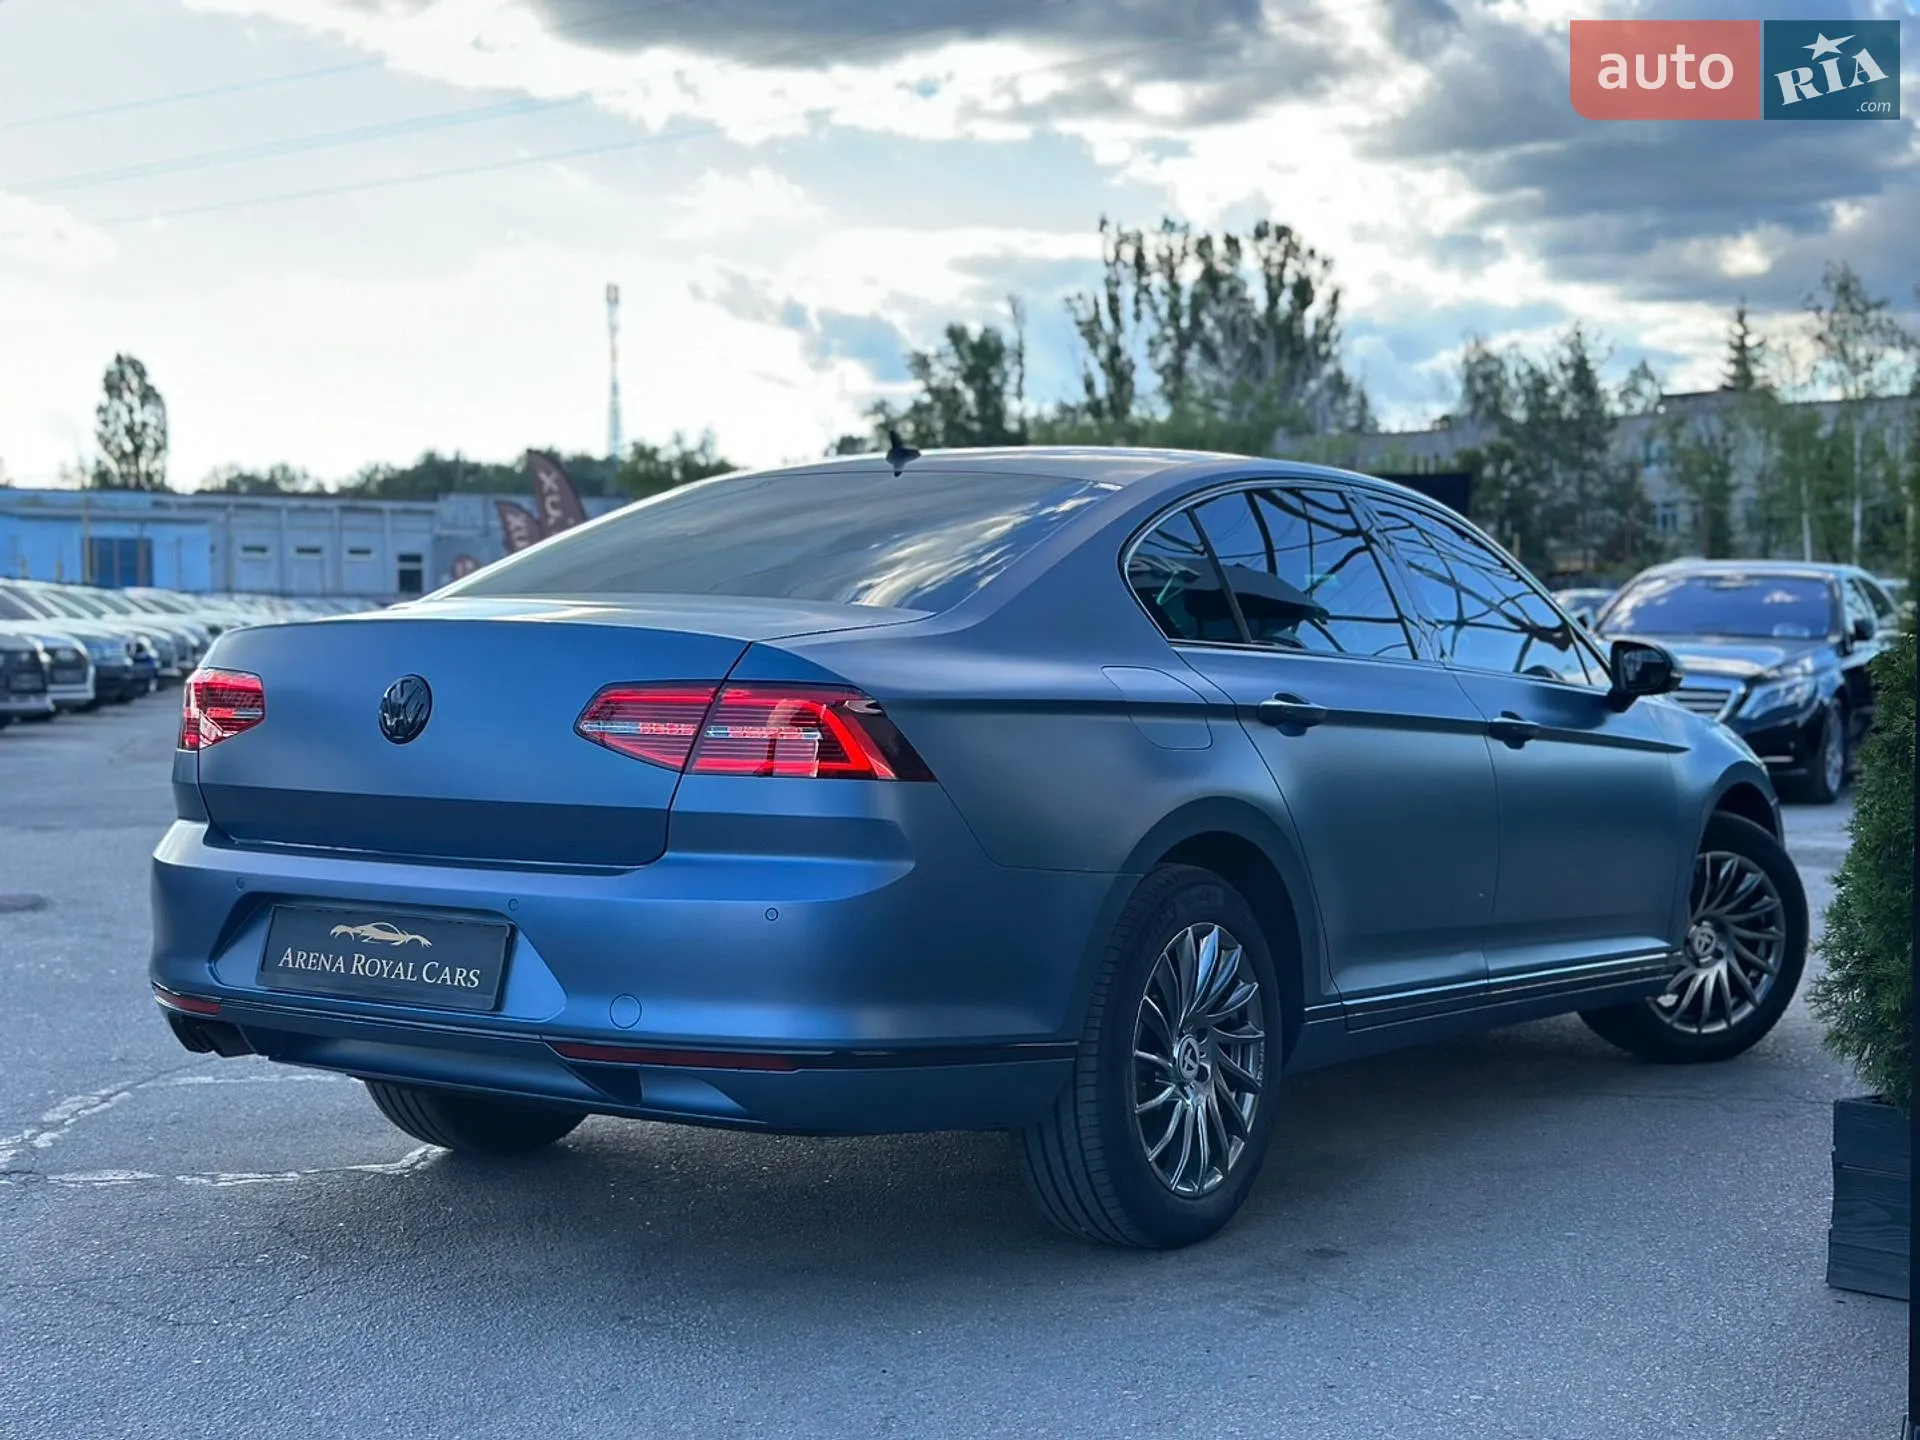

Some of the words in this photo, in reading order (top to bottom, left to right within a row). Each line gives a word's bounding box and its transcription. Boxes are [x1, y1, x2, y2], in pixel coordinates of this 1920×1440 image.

[278, 947, 345, 974] ARENA
[350, 953, 417, 982] ROYAL
[422, 961, 480, 988] CARS
